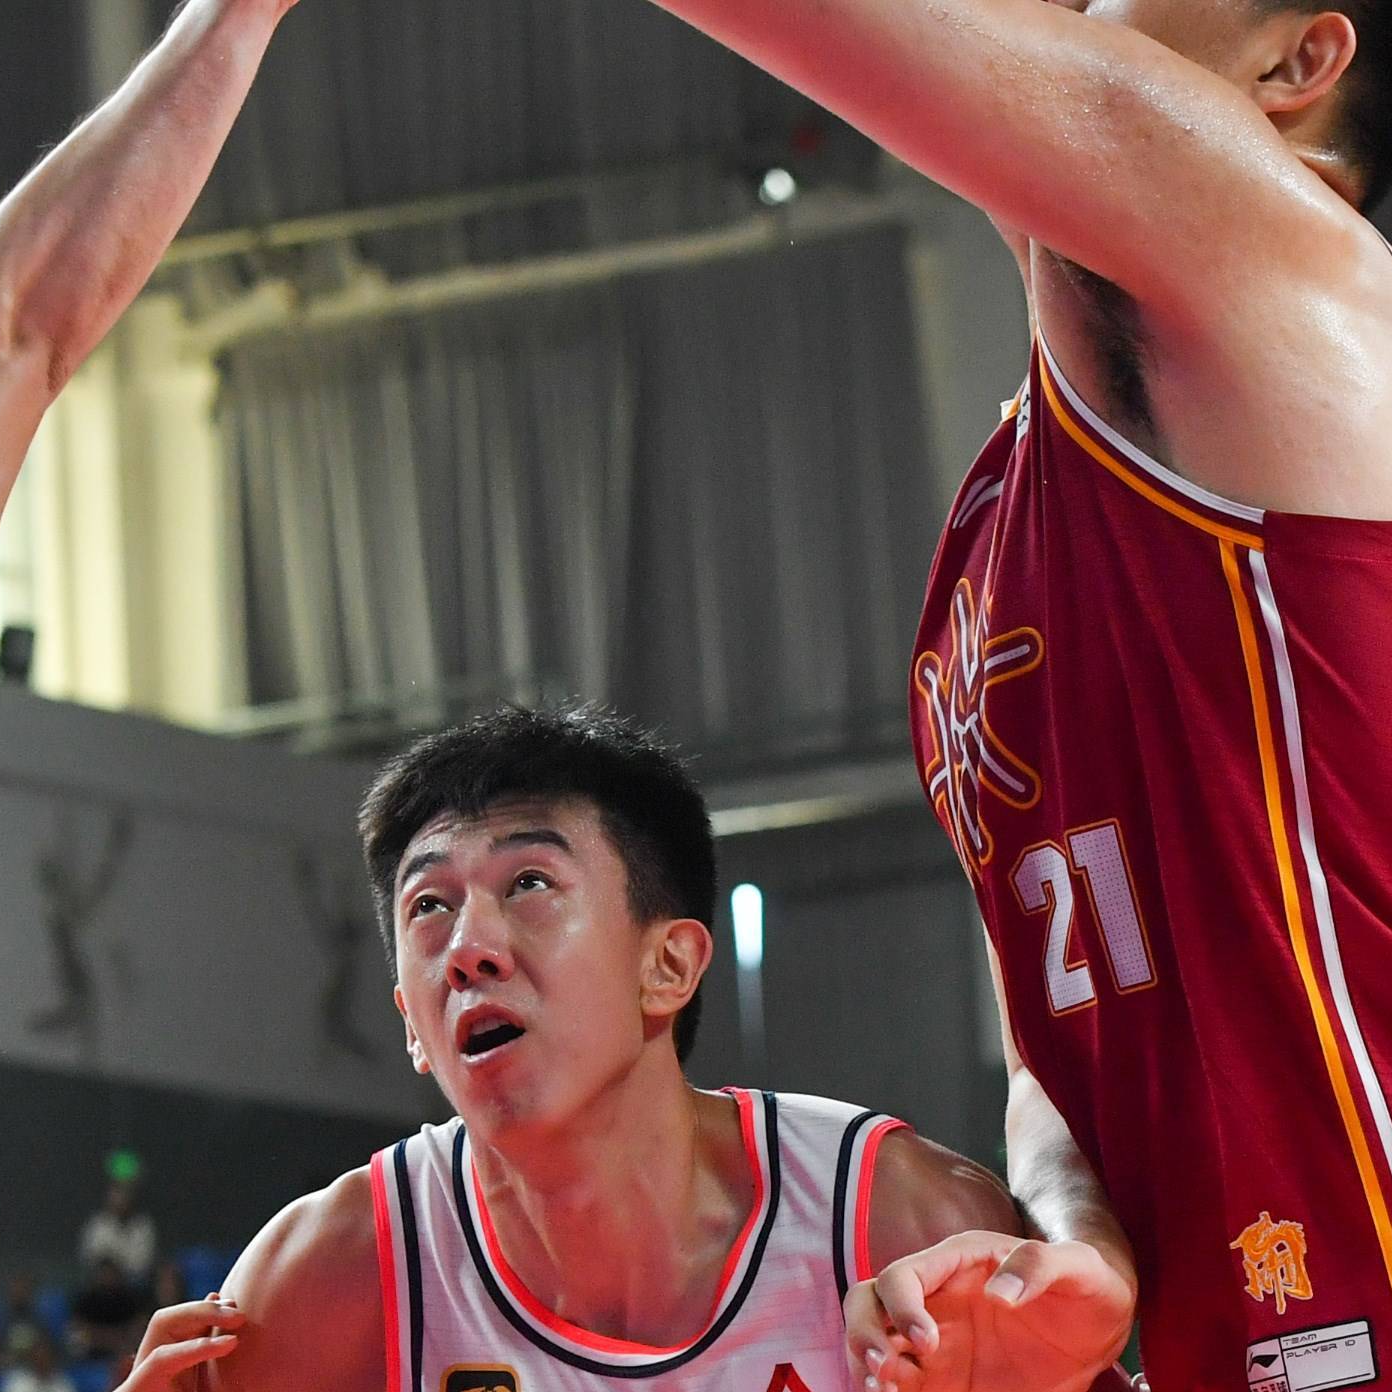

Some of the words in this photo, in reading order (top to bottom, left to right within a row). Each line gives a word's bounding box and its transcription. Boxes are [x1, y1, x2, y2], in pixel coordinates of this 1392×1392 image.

[1009, 817, 1158, 1017] 21
[1282, 1333, 1318, 1346] TEAM
[1286, 1343, 1338, 1359] PLAYER
